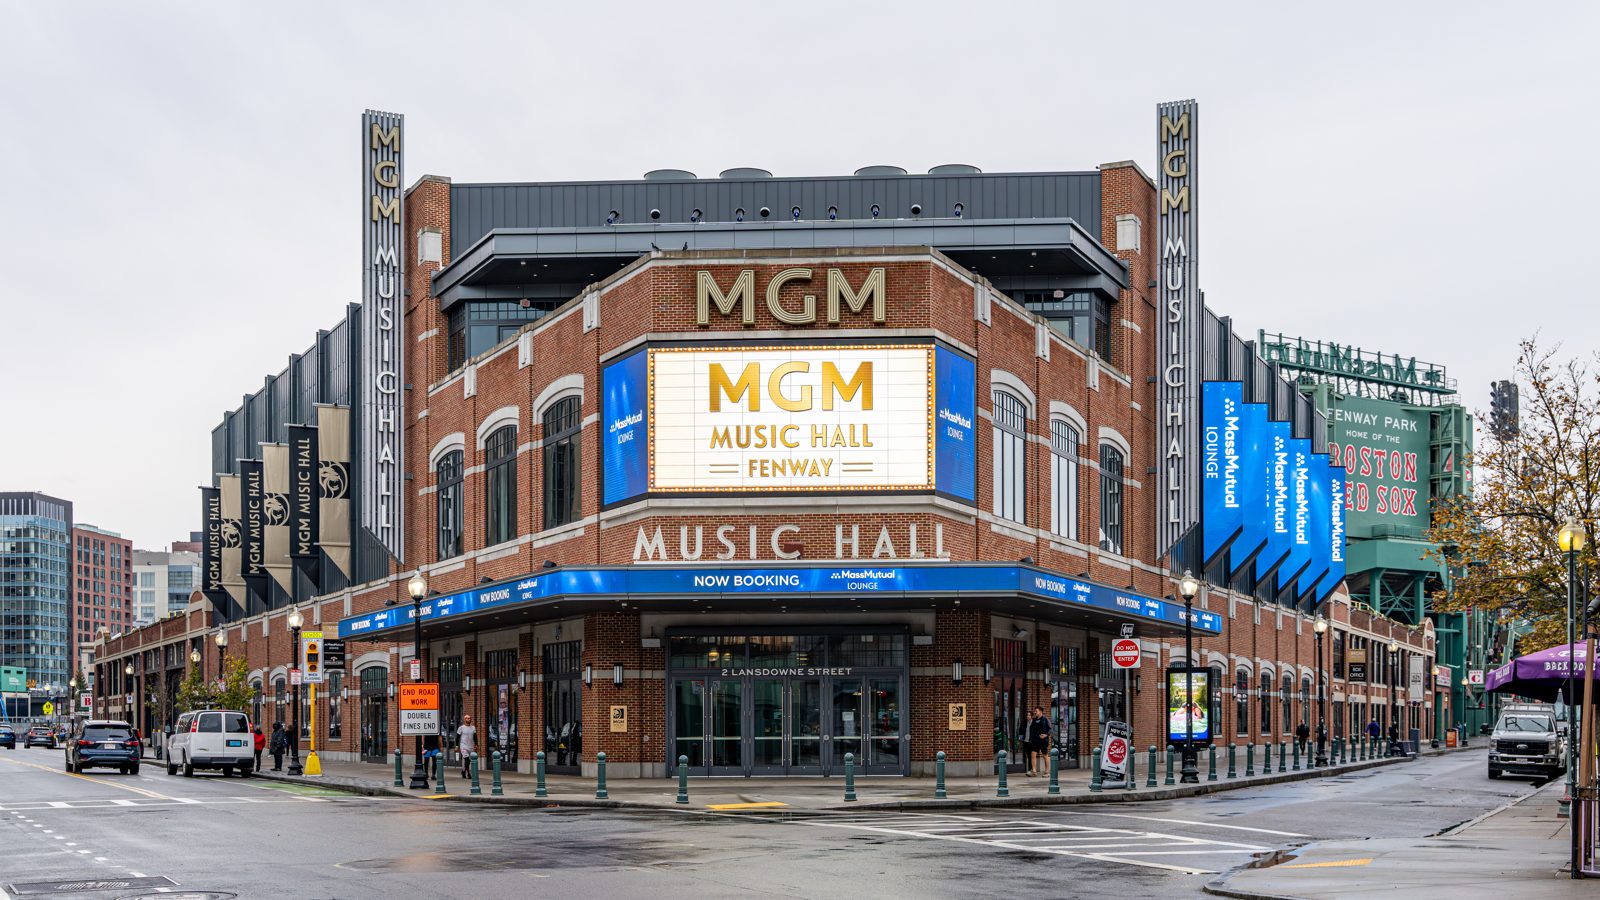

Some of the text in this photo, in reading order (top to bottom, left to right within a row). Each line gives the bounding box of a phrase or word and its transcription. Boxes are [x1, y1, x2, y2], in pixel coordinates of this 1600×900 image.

[696, 267, 888, 327] MGM
[371, 122, 400, 529] MGM MUSIC HALL
[1160, 112, 1189, 524] MGM MUSIC HALL
[708, 360, 874, 413] MGM
[709, 423, 874, 450] MUSIC HALL
[1346, 429, 1401, 444] HOME OF THE
[1384, 416, 1418, 433] PARK
[748, 458, 834, 478] FENWAY
[1206, 426, 1219, 479] LOUNGE
[1224, 416, 1240, 508] MassMutual
[298, 437, 311, 555] MGM MUSIC HALL
[1274, 452, 1288, 533] MassMutual
[1296, 468, 1309, 545] MassMutual
[1345, 480, 1418, 517] ED SOX
[249, 470, 260, 574] MGM MUSIC HALL
[1331, 492, 1344, 562] MassMutual
[209, 496, 220, 590] MGM MUSIC HALL
[633, 522, 952, 560] MUSIC HALL
[694, 574, 800, 587] NOW BOOKING
[841, 569, 896, 580] MassMutual
[847, 581, 878, 590] LOUNGE
[1035, 577, 1066, 594] NOW BOOKING
[480, 588, 510, 604] NOW BOOKING
[721, 668, 853, 677] 2 LANSDOWNE STREET
[1544, 661, 1569, 671] BACK
[418, 688, 436, 696] ROAD
[407, 712, 432, 720] DOUBLE
[423, 722, 436, 730] END
